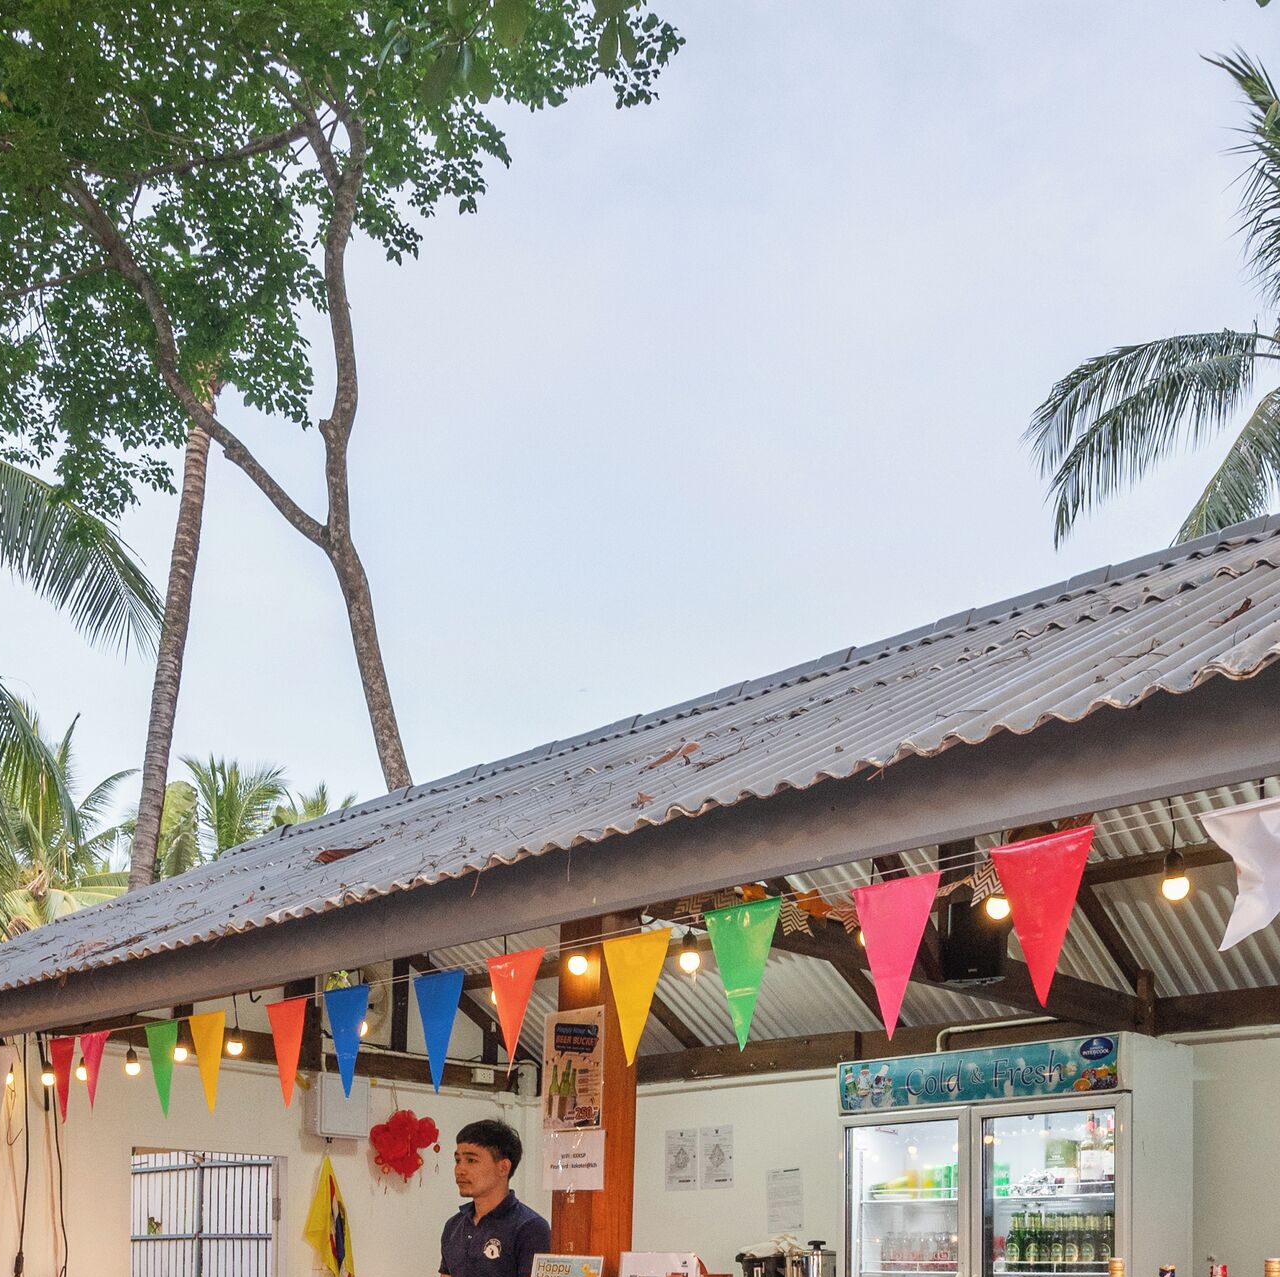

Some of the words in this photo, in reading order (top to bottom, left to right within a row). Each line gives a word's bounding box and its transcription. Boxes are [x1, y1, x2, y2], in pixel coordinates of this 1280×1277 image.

[904, 1058, 964, 1097] Cold
[970, 1066, 985, 1085] &
[991, 1049, 1066, 1089] Fresh
[537, 1262, 572, 1275] Happy
